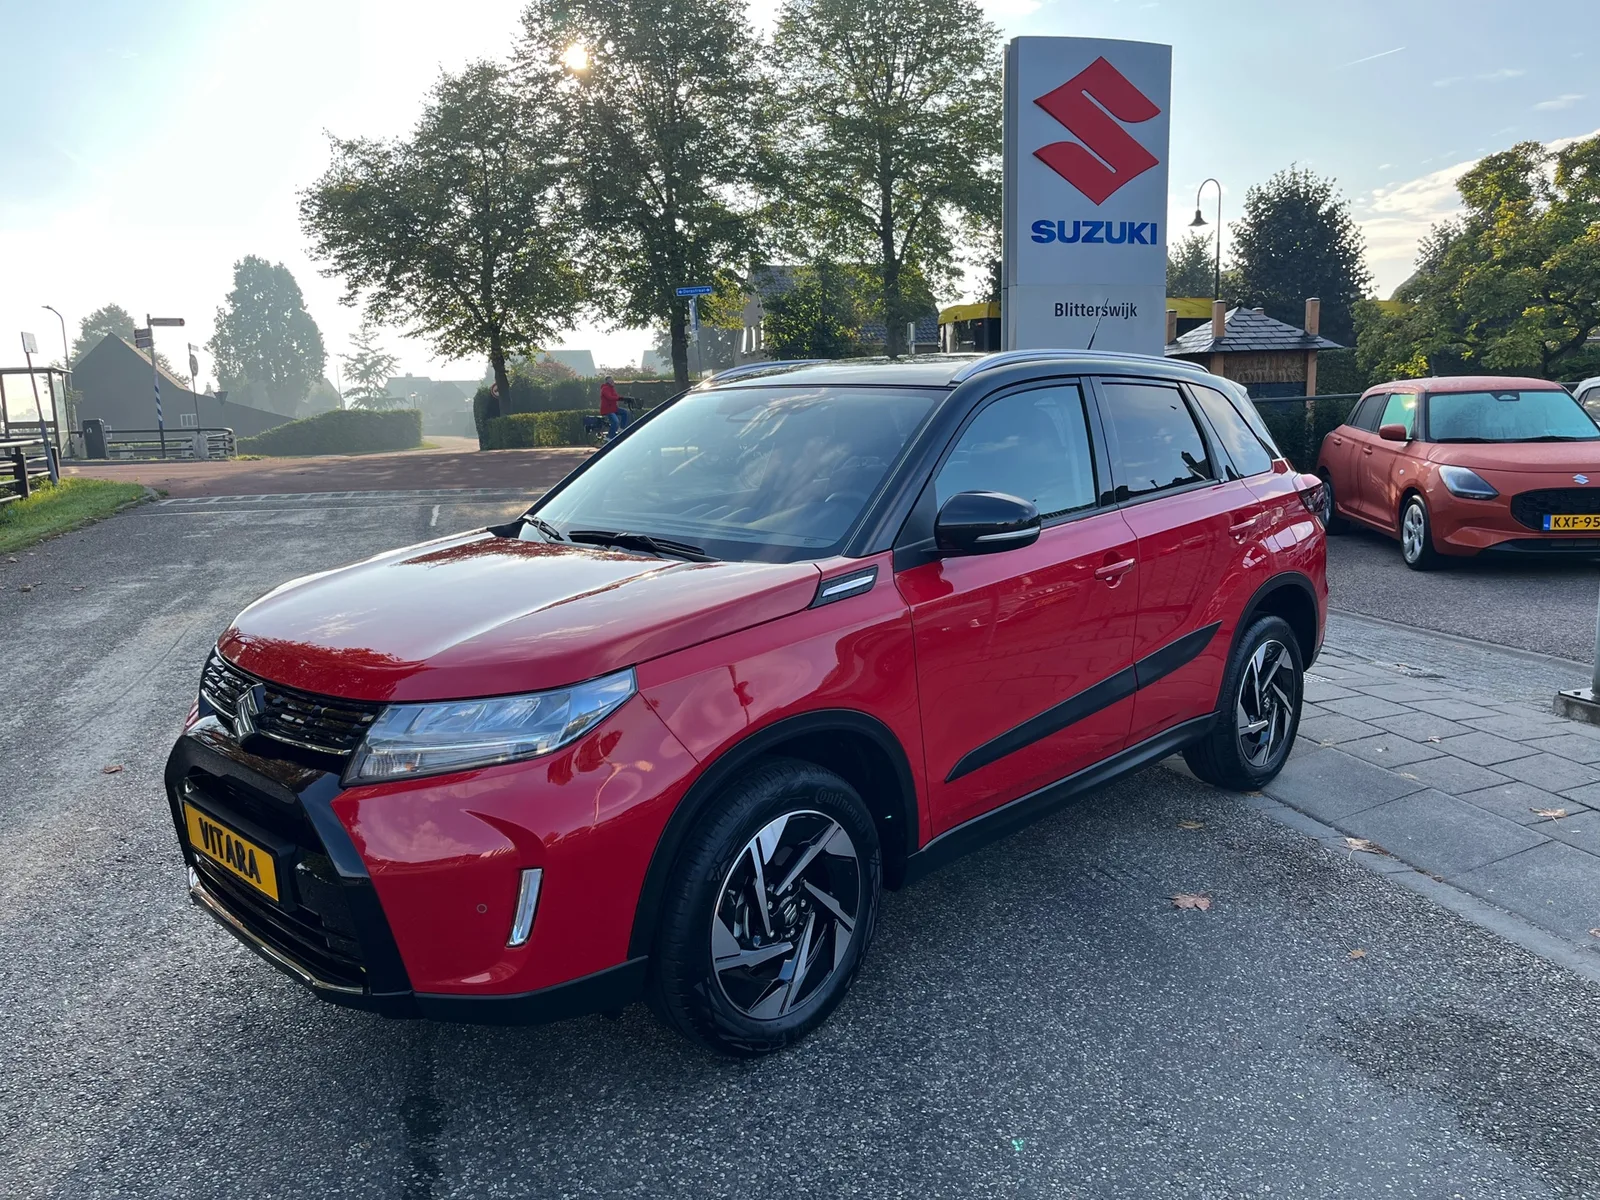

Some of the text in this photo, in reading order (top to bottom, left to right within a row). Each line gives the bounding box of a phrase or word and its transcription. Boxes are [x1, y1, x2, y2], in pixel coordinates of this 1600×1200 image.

[1031, 220, 1157, 245] SUZUKI
[1054, 302, 1138, 319] Blitterswijk
[1553, 516, 1600, 528] KXF-95
[198, 817, 262, 884] VITARA
